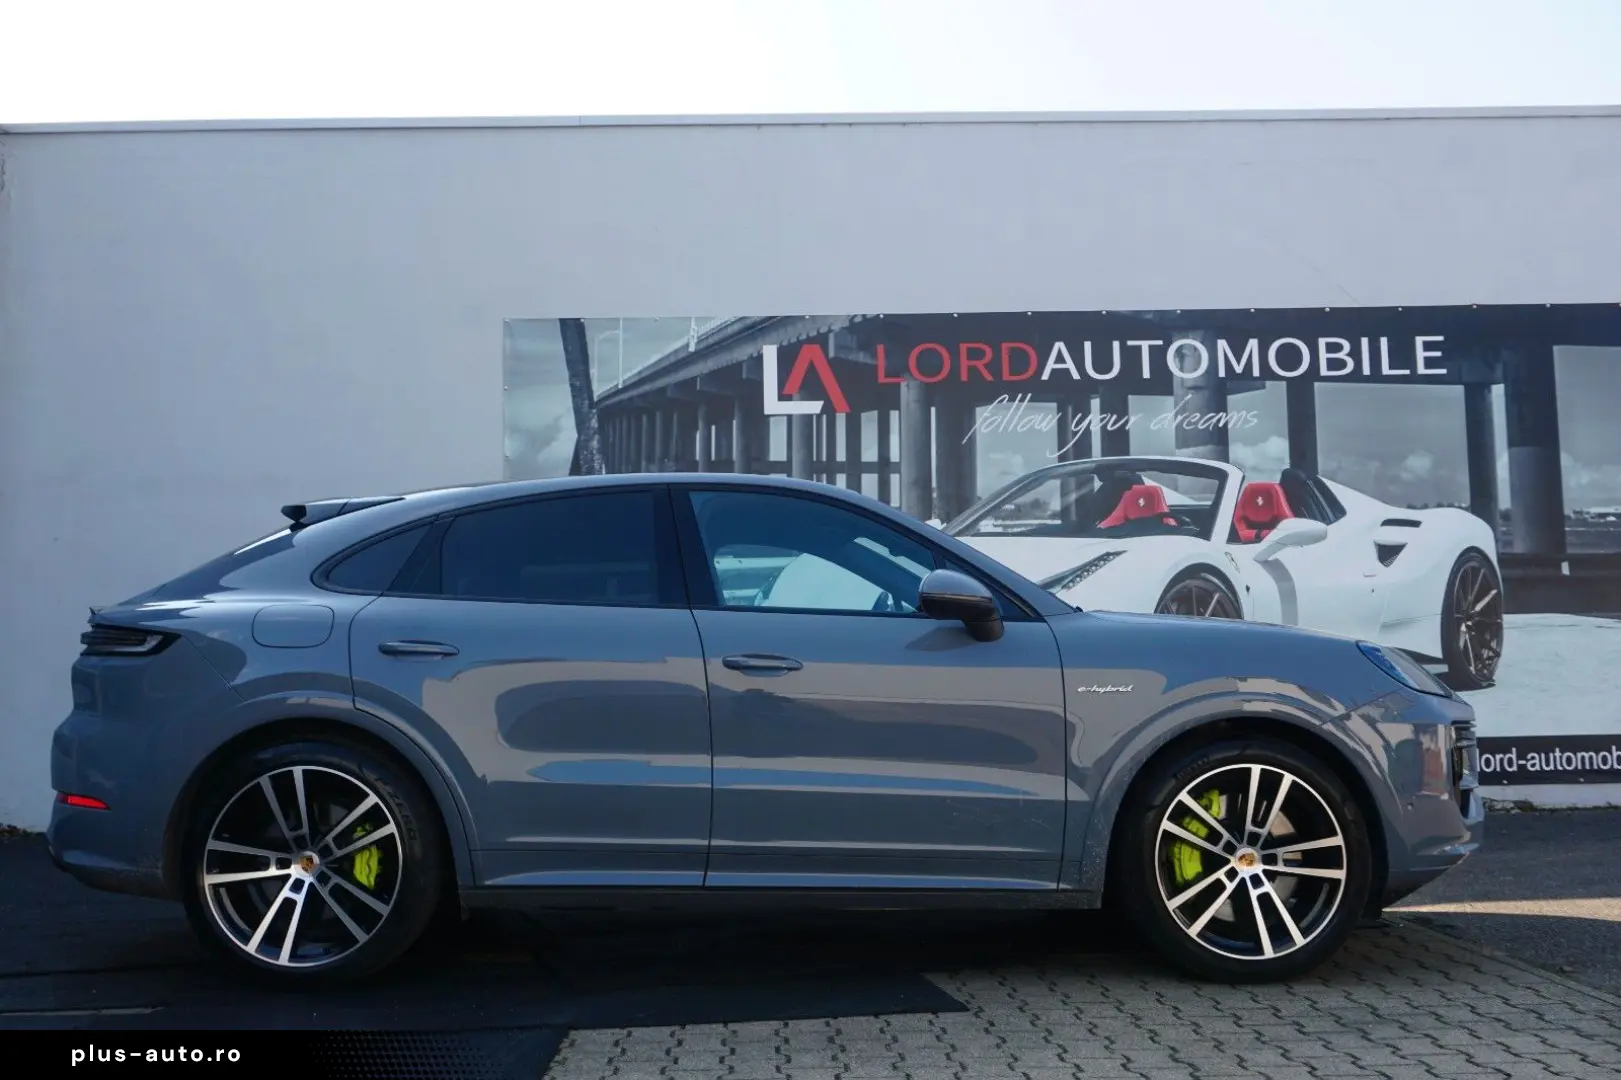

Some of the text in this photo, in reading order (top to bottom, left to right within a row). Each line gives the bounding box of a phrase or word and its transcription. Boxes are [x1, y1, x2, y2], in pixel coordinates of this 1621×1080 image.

[962, 393, 1258, 457] follow your dreams
[1077, 684, 1133, 694] e-hybrid
